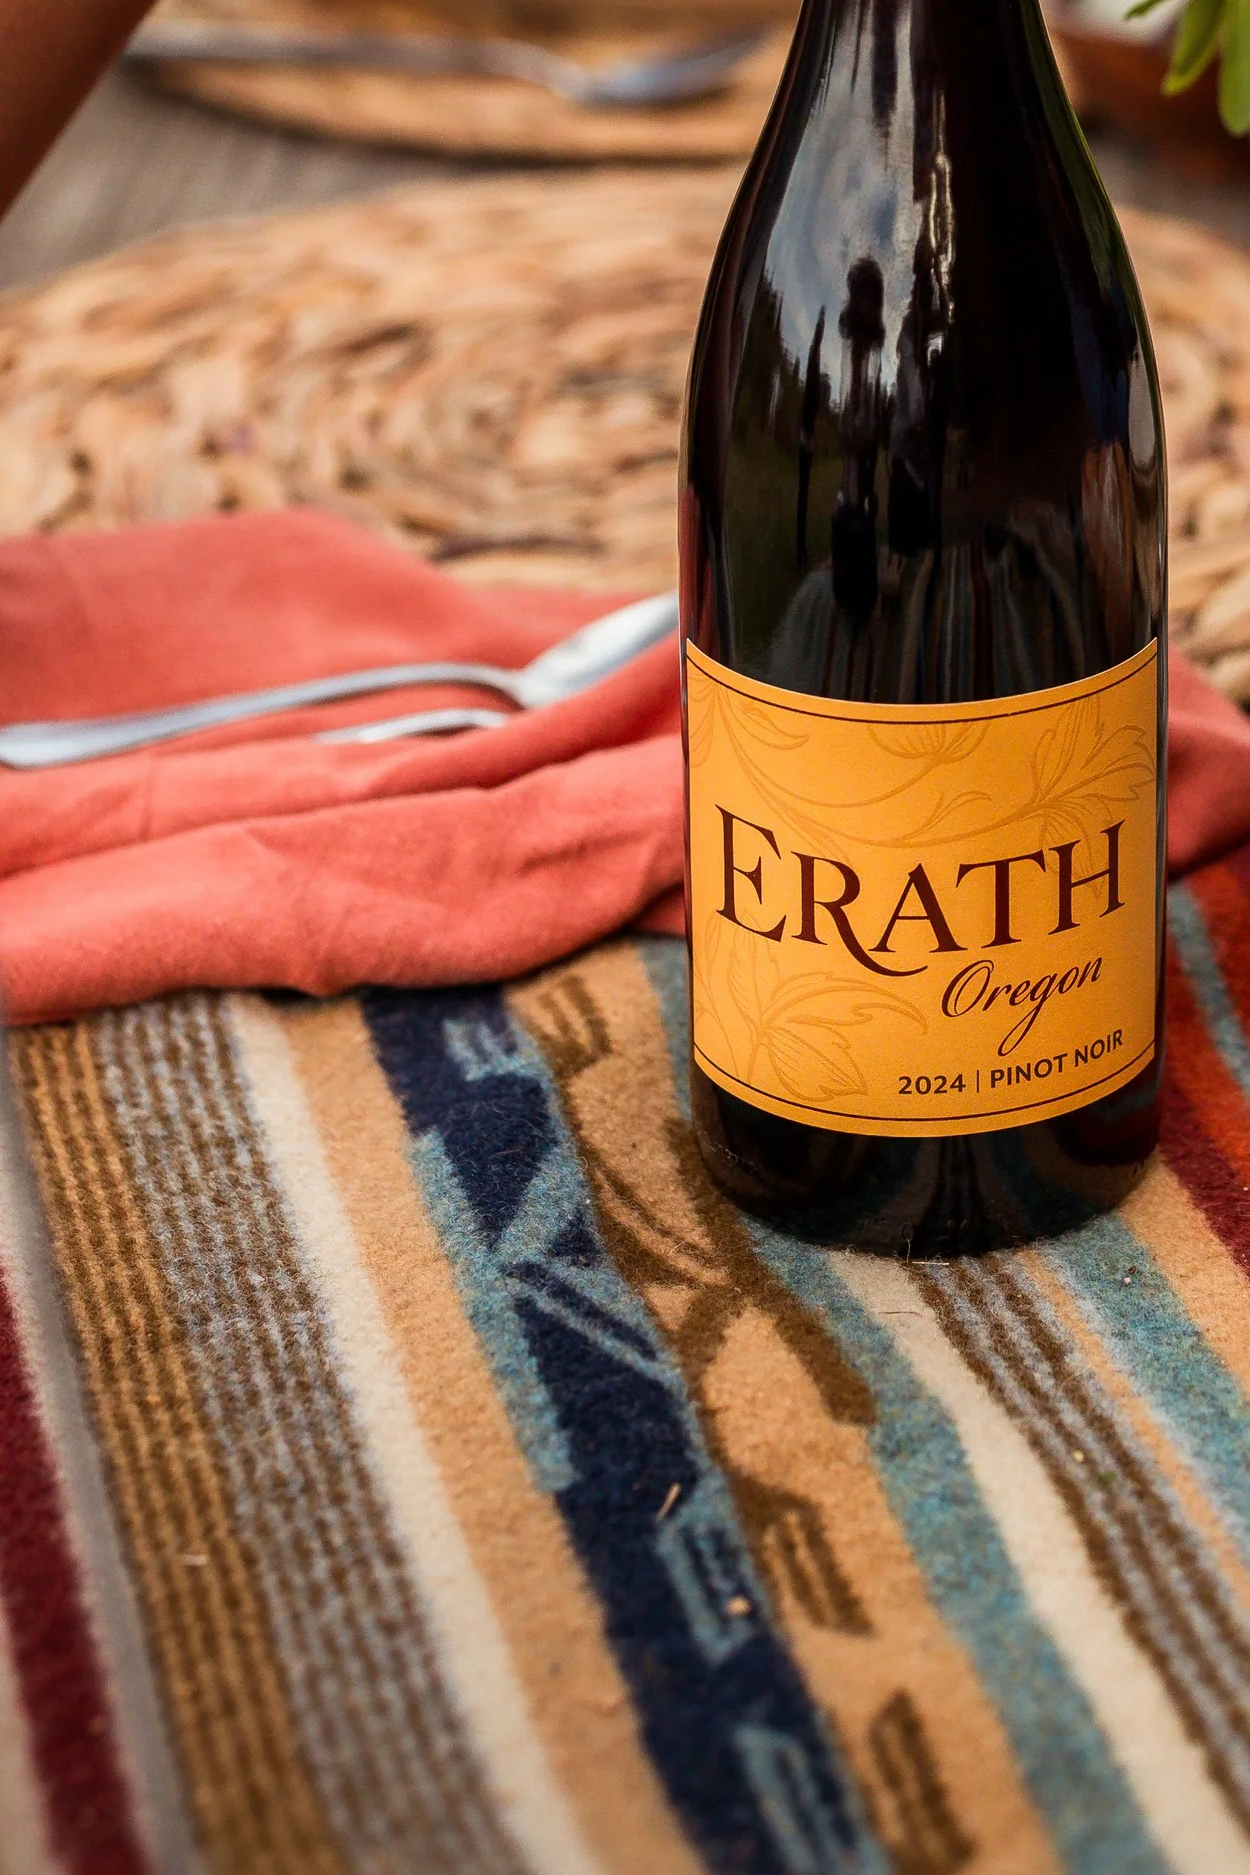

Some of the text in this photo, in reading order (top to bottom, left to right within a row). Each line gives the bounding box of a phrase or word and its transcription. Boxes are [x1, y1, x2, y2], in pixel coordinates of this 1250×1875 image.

[715, 804, 1126, 977] ERATH
[942, 957, 1103, 1056] Oregon
[898, 1069, 967, 1097] 2024
[990, 1053, 1070, 1089] PINOT
[1074, 1028, 1124, 1068] NOIR
